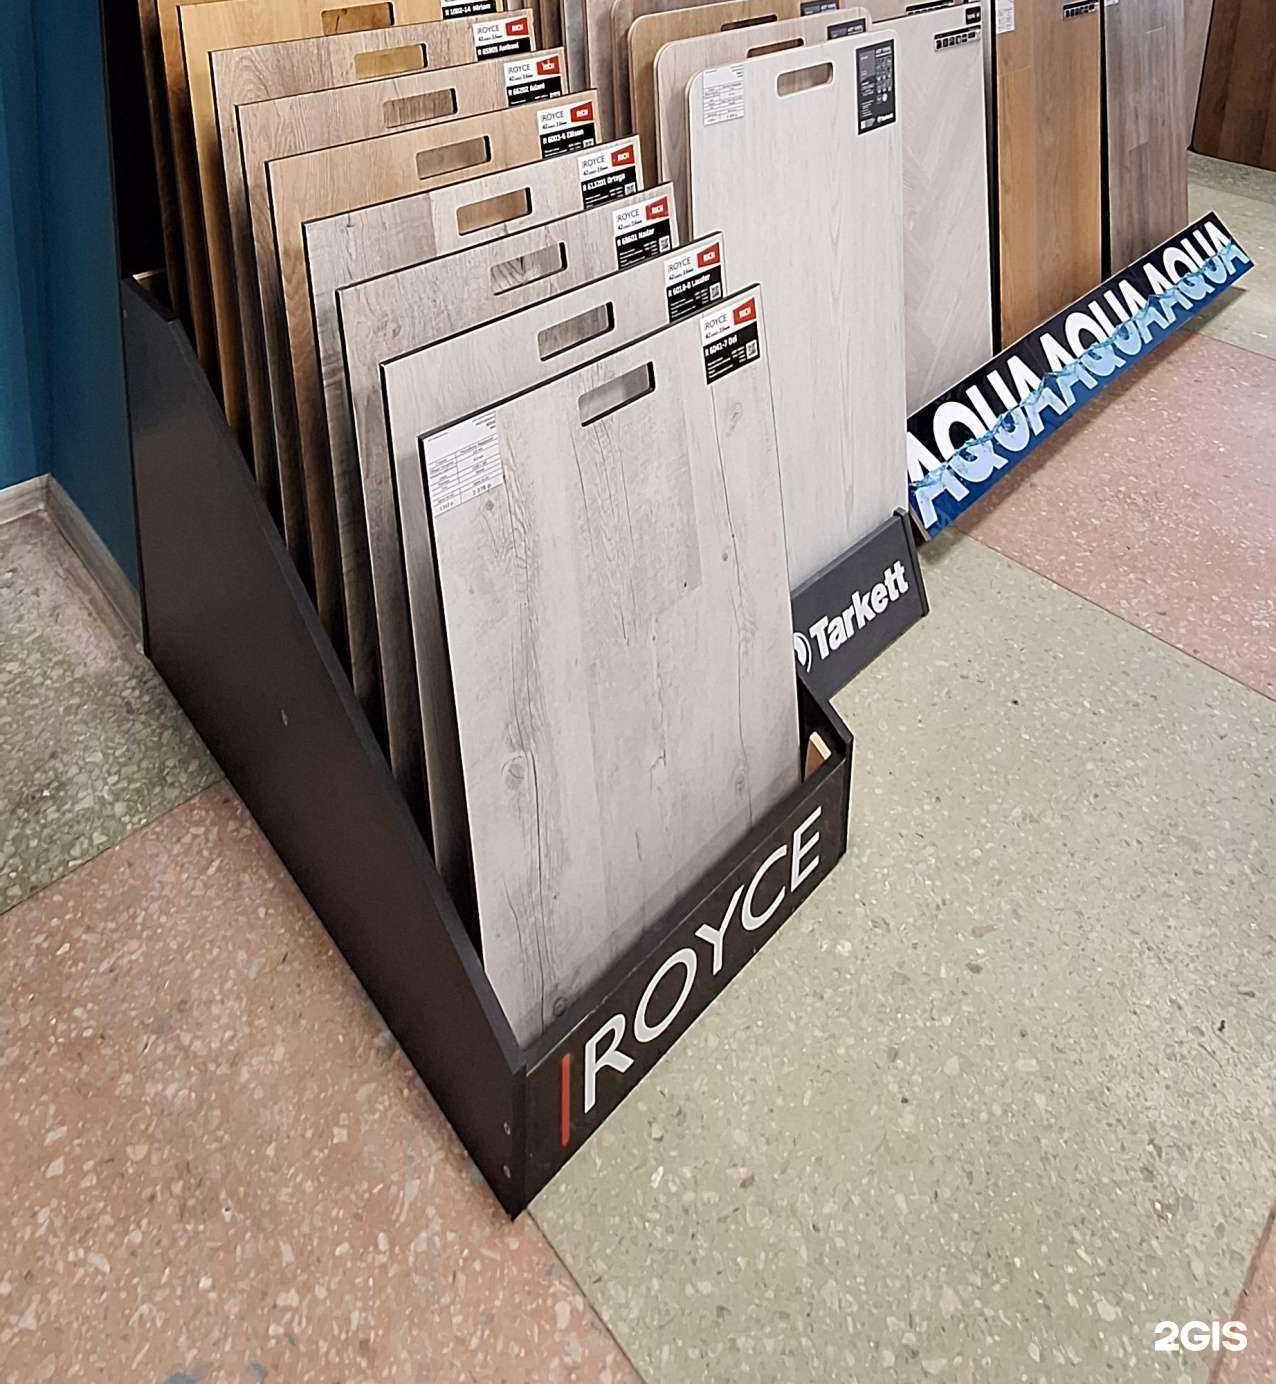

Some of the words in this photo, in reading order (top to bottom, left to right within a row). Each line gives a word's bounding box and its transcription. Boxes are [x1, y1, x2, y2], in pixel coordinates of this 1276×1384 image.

[616, 209, 640, 223] ROYCE
[668, 257, 691, 272] ROYCE
[704, 314, 728, 329] ROYCE
[810, 560, 911, 660] Tarkett
[583, 806, 822, 1114] ROYCE
